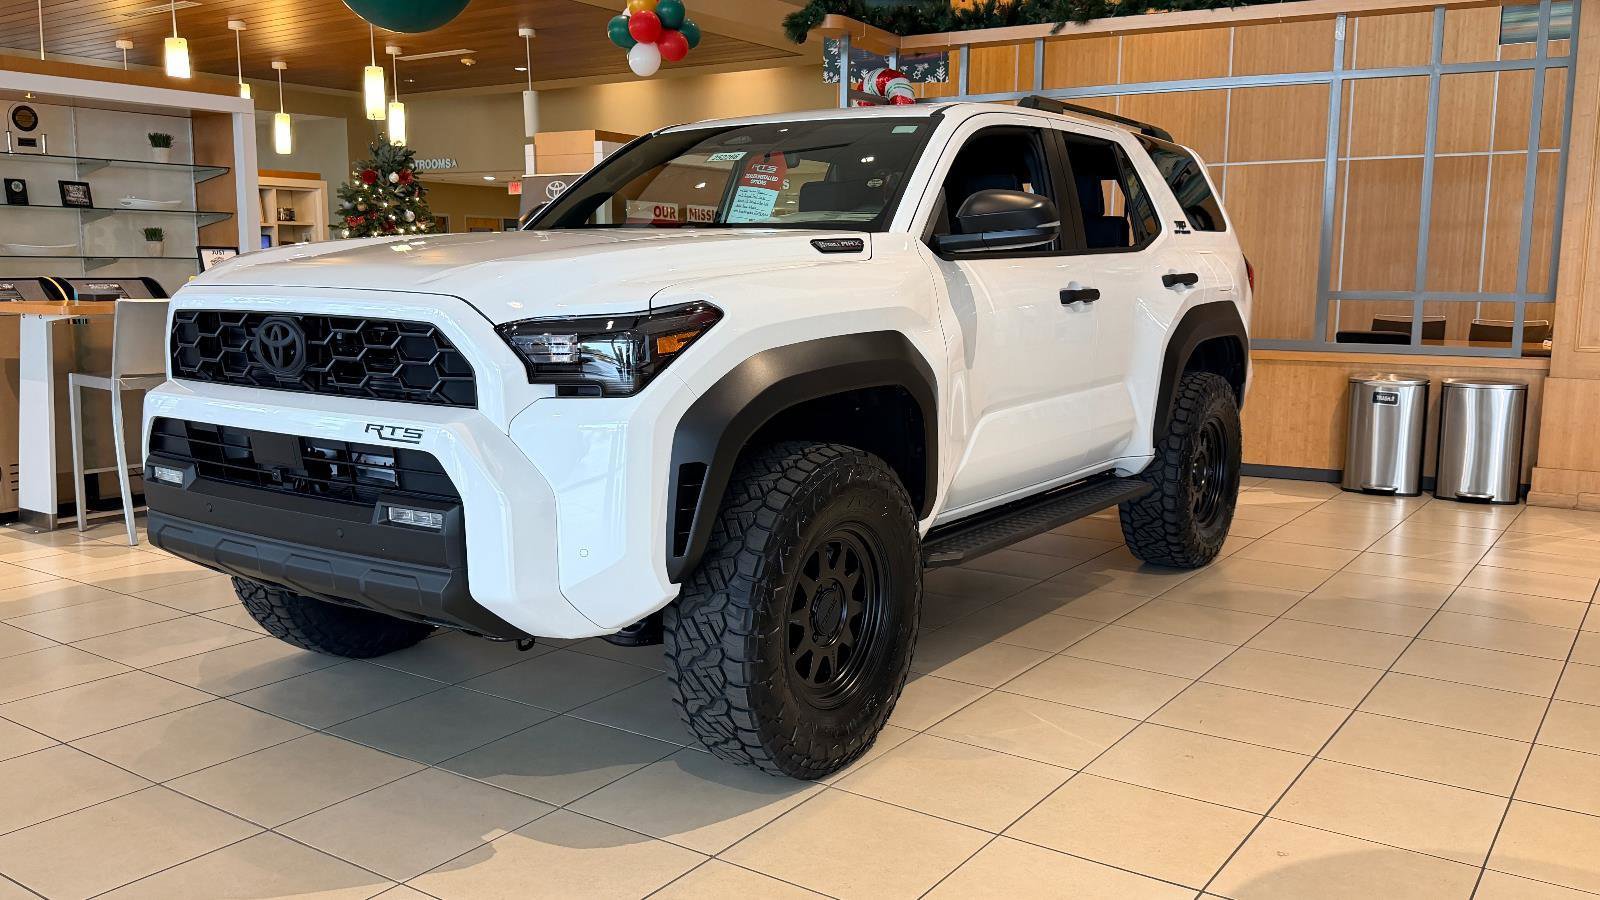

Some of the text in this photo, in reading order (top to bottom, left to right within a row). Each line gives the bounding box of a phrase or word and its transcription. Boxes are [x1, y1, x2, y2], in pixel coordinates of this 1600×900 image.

[414, 158, 451, 169] TROOMS
[653, 206, 714, 221] OUR MISSI
[365, 423, 424, 444] RTS
